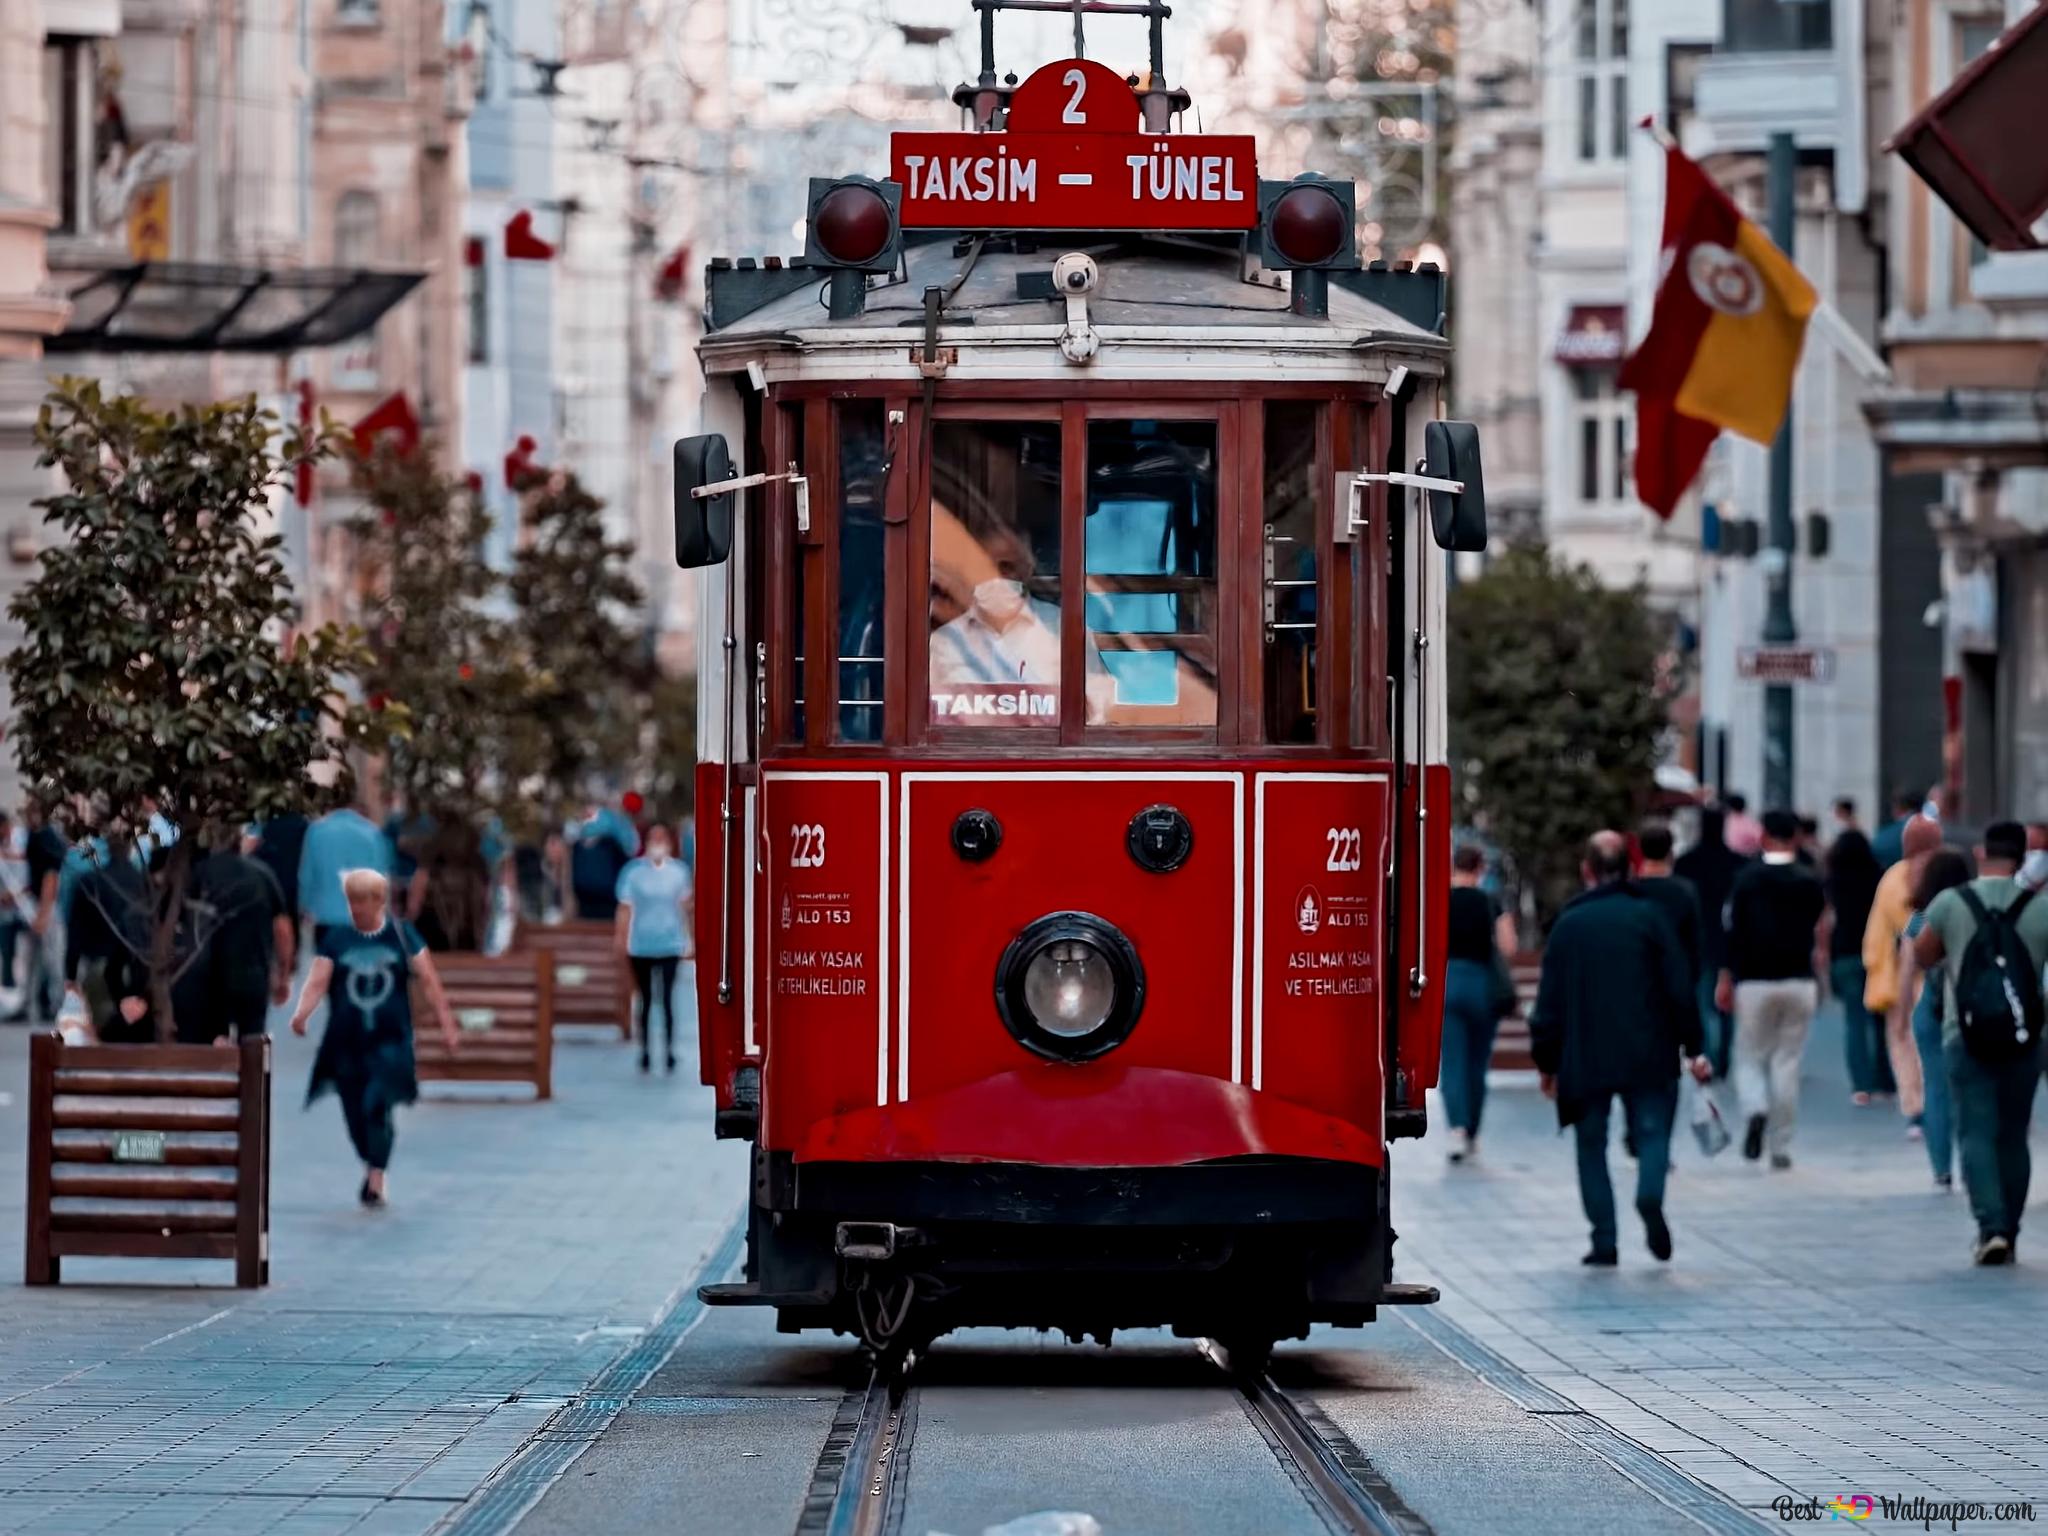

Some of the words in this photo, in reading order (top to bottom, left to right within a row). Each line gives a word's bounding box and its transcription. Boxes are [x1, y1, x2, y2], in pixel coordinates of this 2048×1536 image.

[1062, 69, 1086, 124] 2
[904, 144, 1037, 202] TAKSİM
[1127, 142, 1244, 201] TÜNEL
[931, 689, 1055, 716] TAKSİM
[790, 824, 825, 868] 223
[1327, 828, 1361, 871] 223
[825, 910, 851, 924] 153
[1354, 912, 1369, 926] 153
[820, 951, 863, 968] YASAK
[1288, 952, 1345, 969] ASILMAK
[1285, 979, 1303, 996] VE
